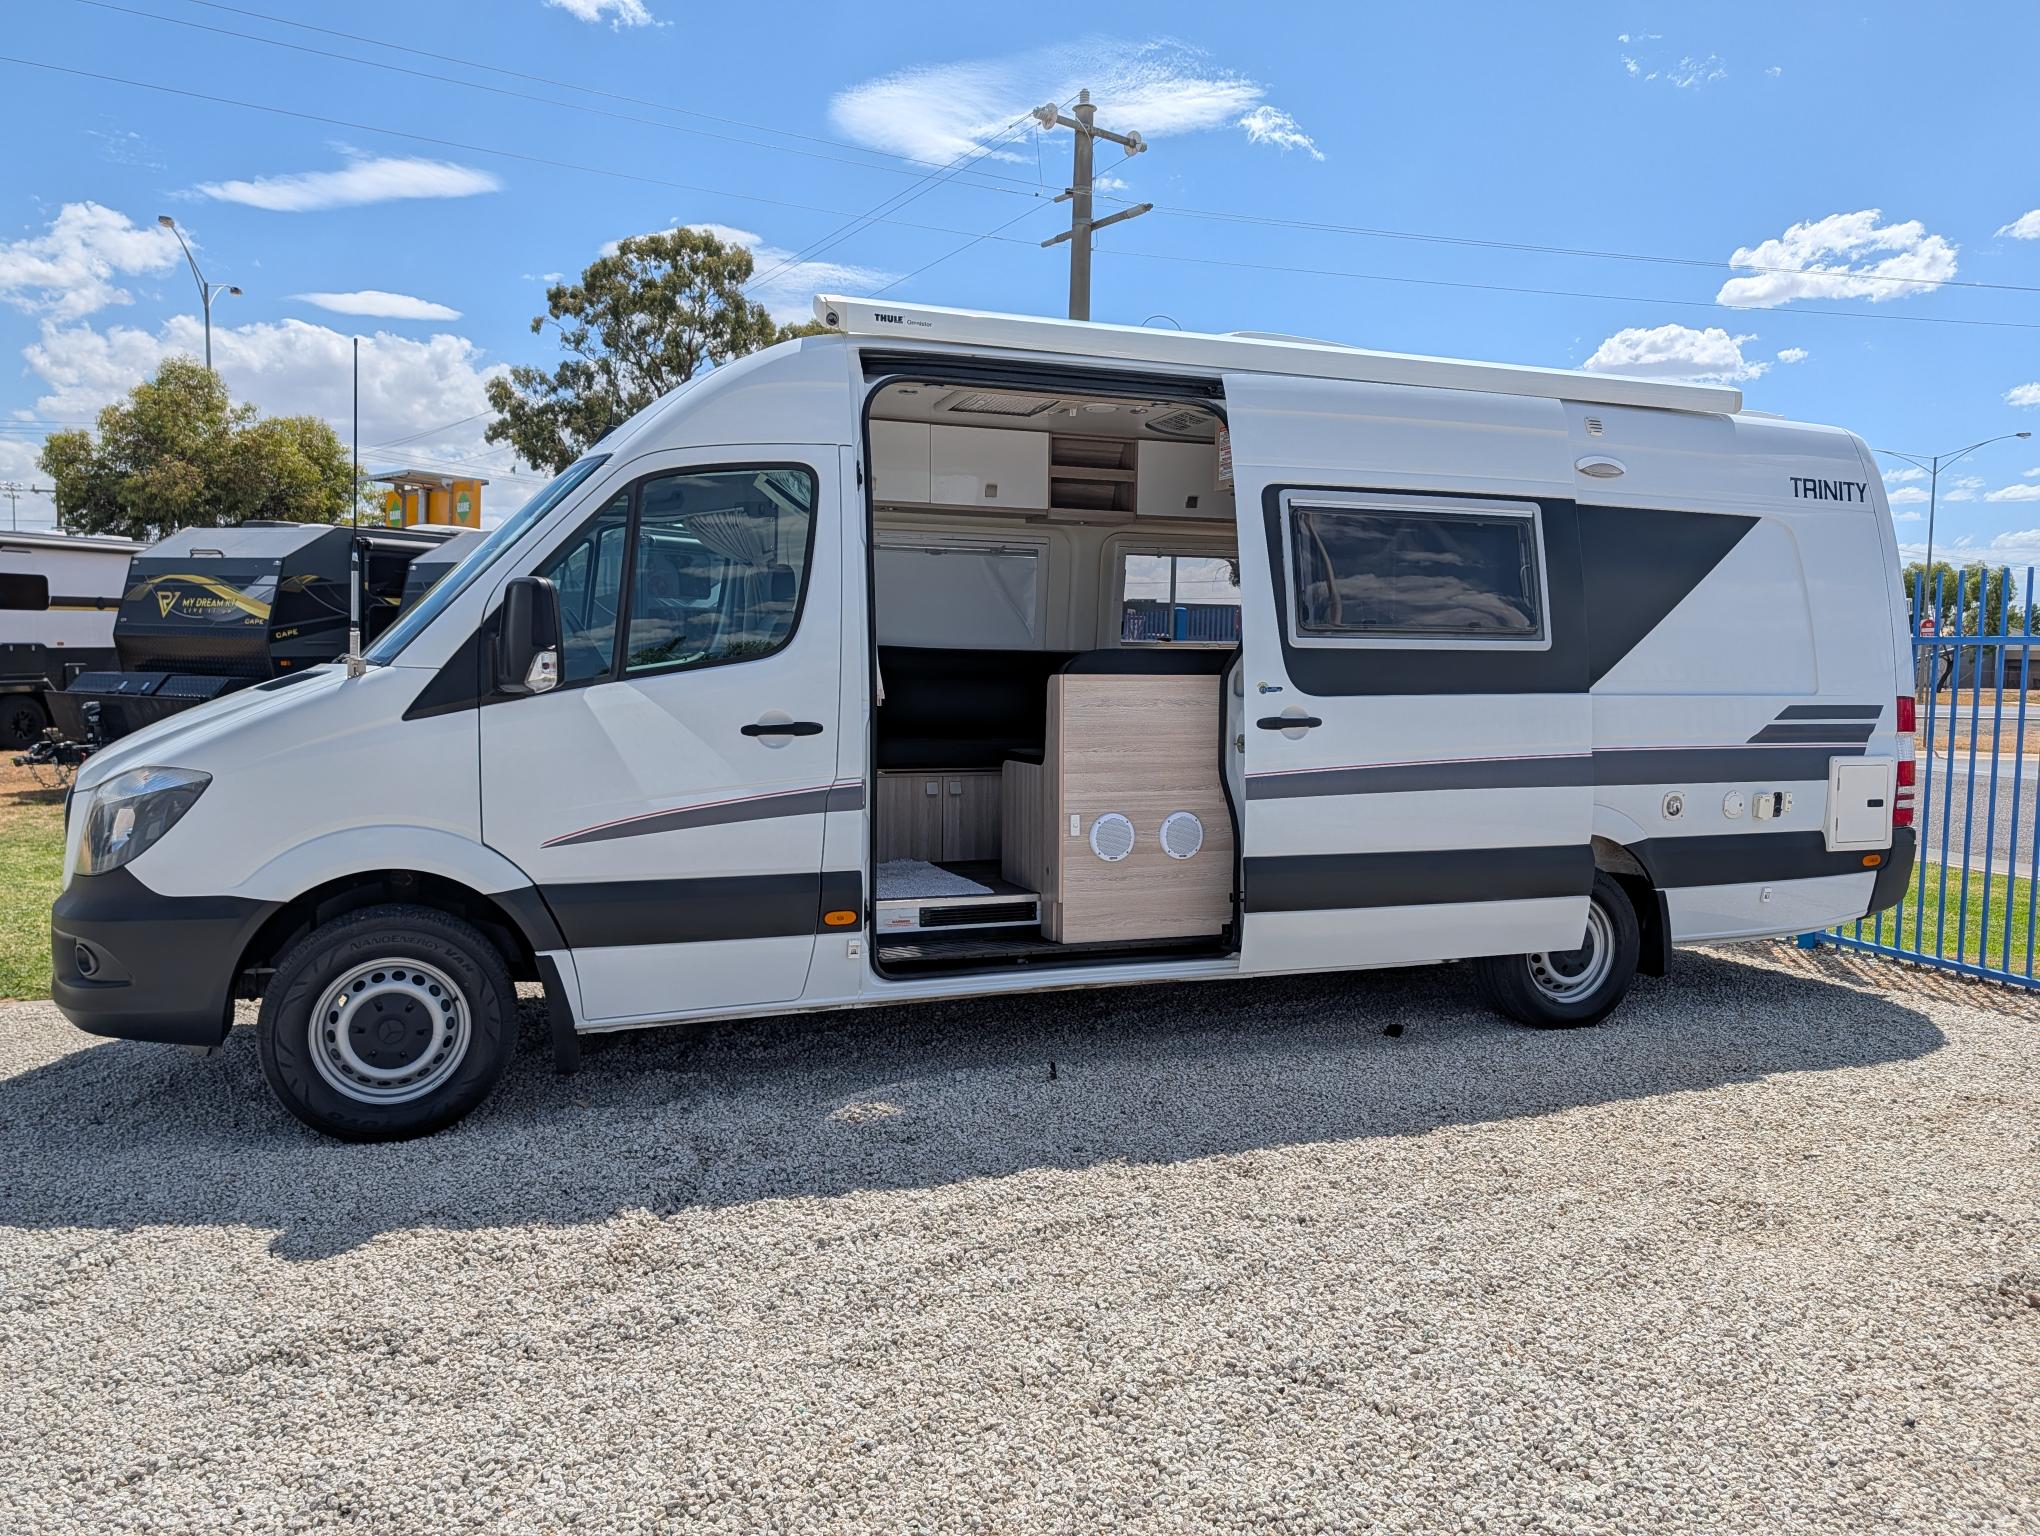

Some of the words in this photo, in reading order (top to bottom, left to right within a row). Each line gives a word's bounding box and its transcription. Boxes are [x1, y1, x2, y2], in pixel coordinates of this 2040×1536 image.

[874, 313, 904, 324] THULE
[1789, 476, 1867, 503] TRINITY
[182, 598, 195, 607] MY
[195, 597, 224, 607] DREAM
[275, 628, 299, 639] CAPE
[350, 935, 440, 951] NANOENERGY
[444, 948, 475, 972] VAN
